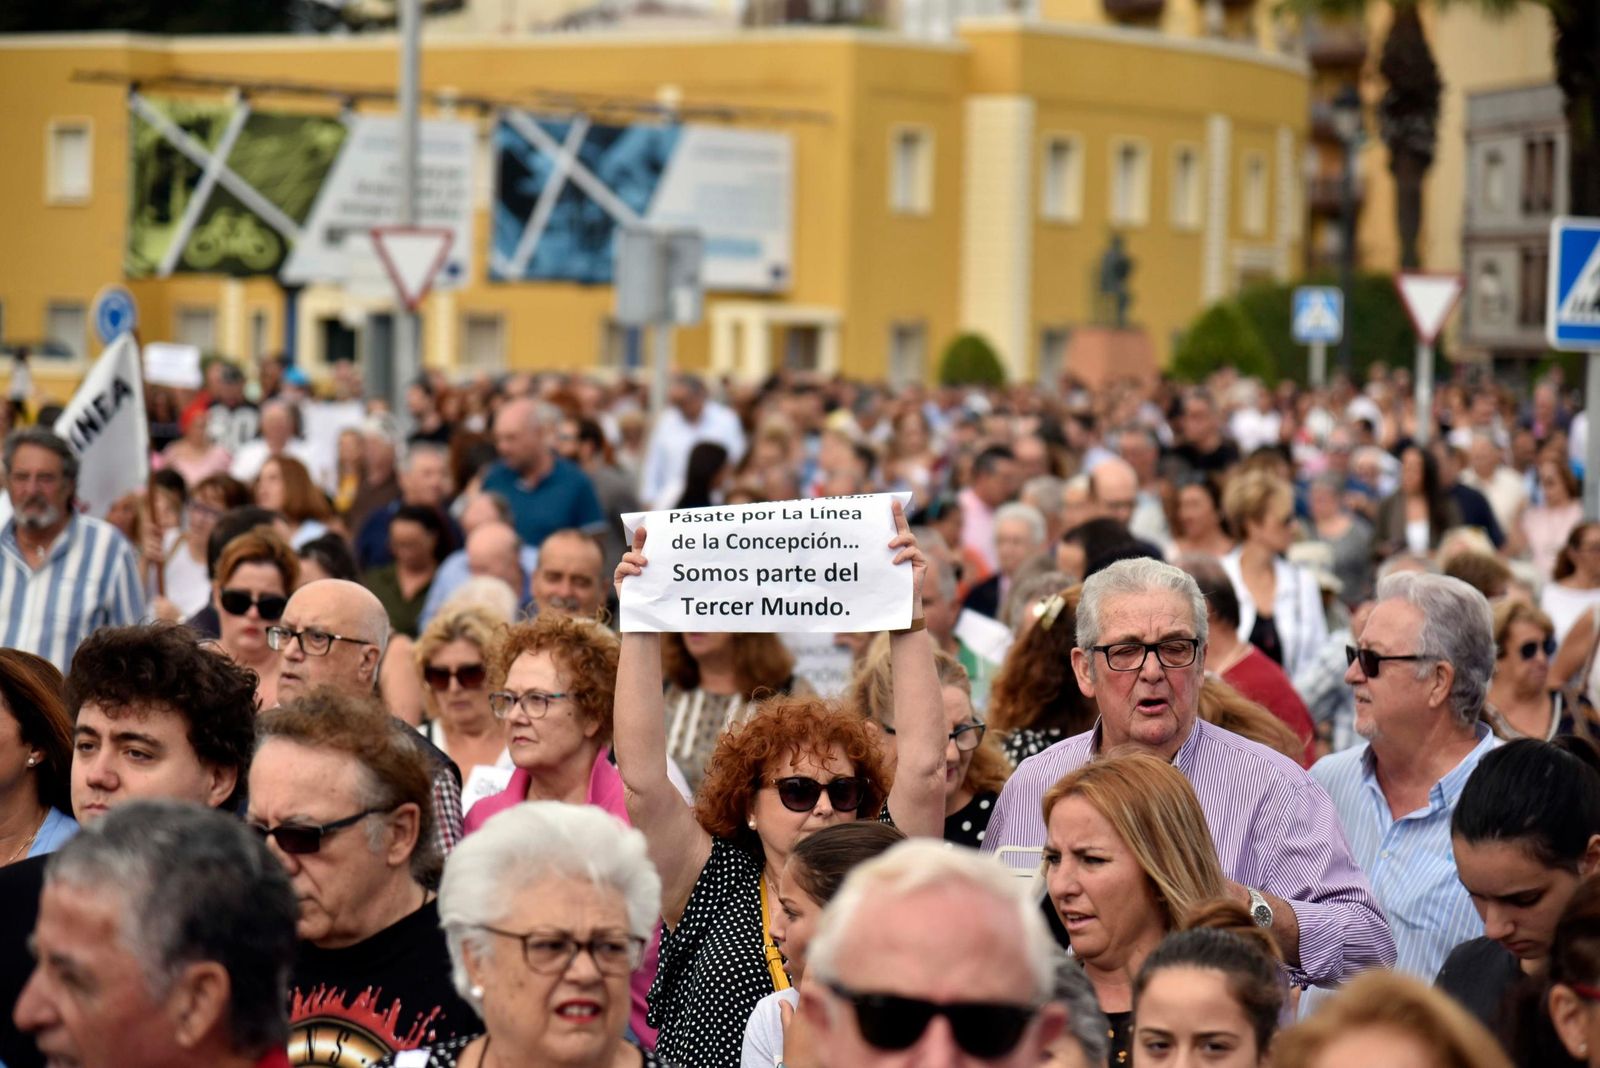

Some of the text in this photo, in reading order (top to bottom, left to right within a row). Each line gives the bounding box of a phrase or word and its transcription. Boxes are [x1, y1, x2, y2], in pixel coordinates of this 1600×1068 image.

[669, 506, 862, 524] Pásate por La Línea
[671, 532, 859, 554] de la Concepción...
[672, 562, 859, 587] Somos parte del
[680, 596, 851, 616] Tercer Mundo.
